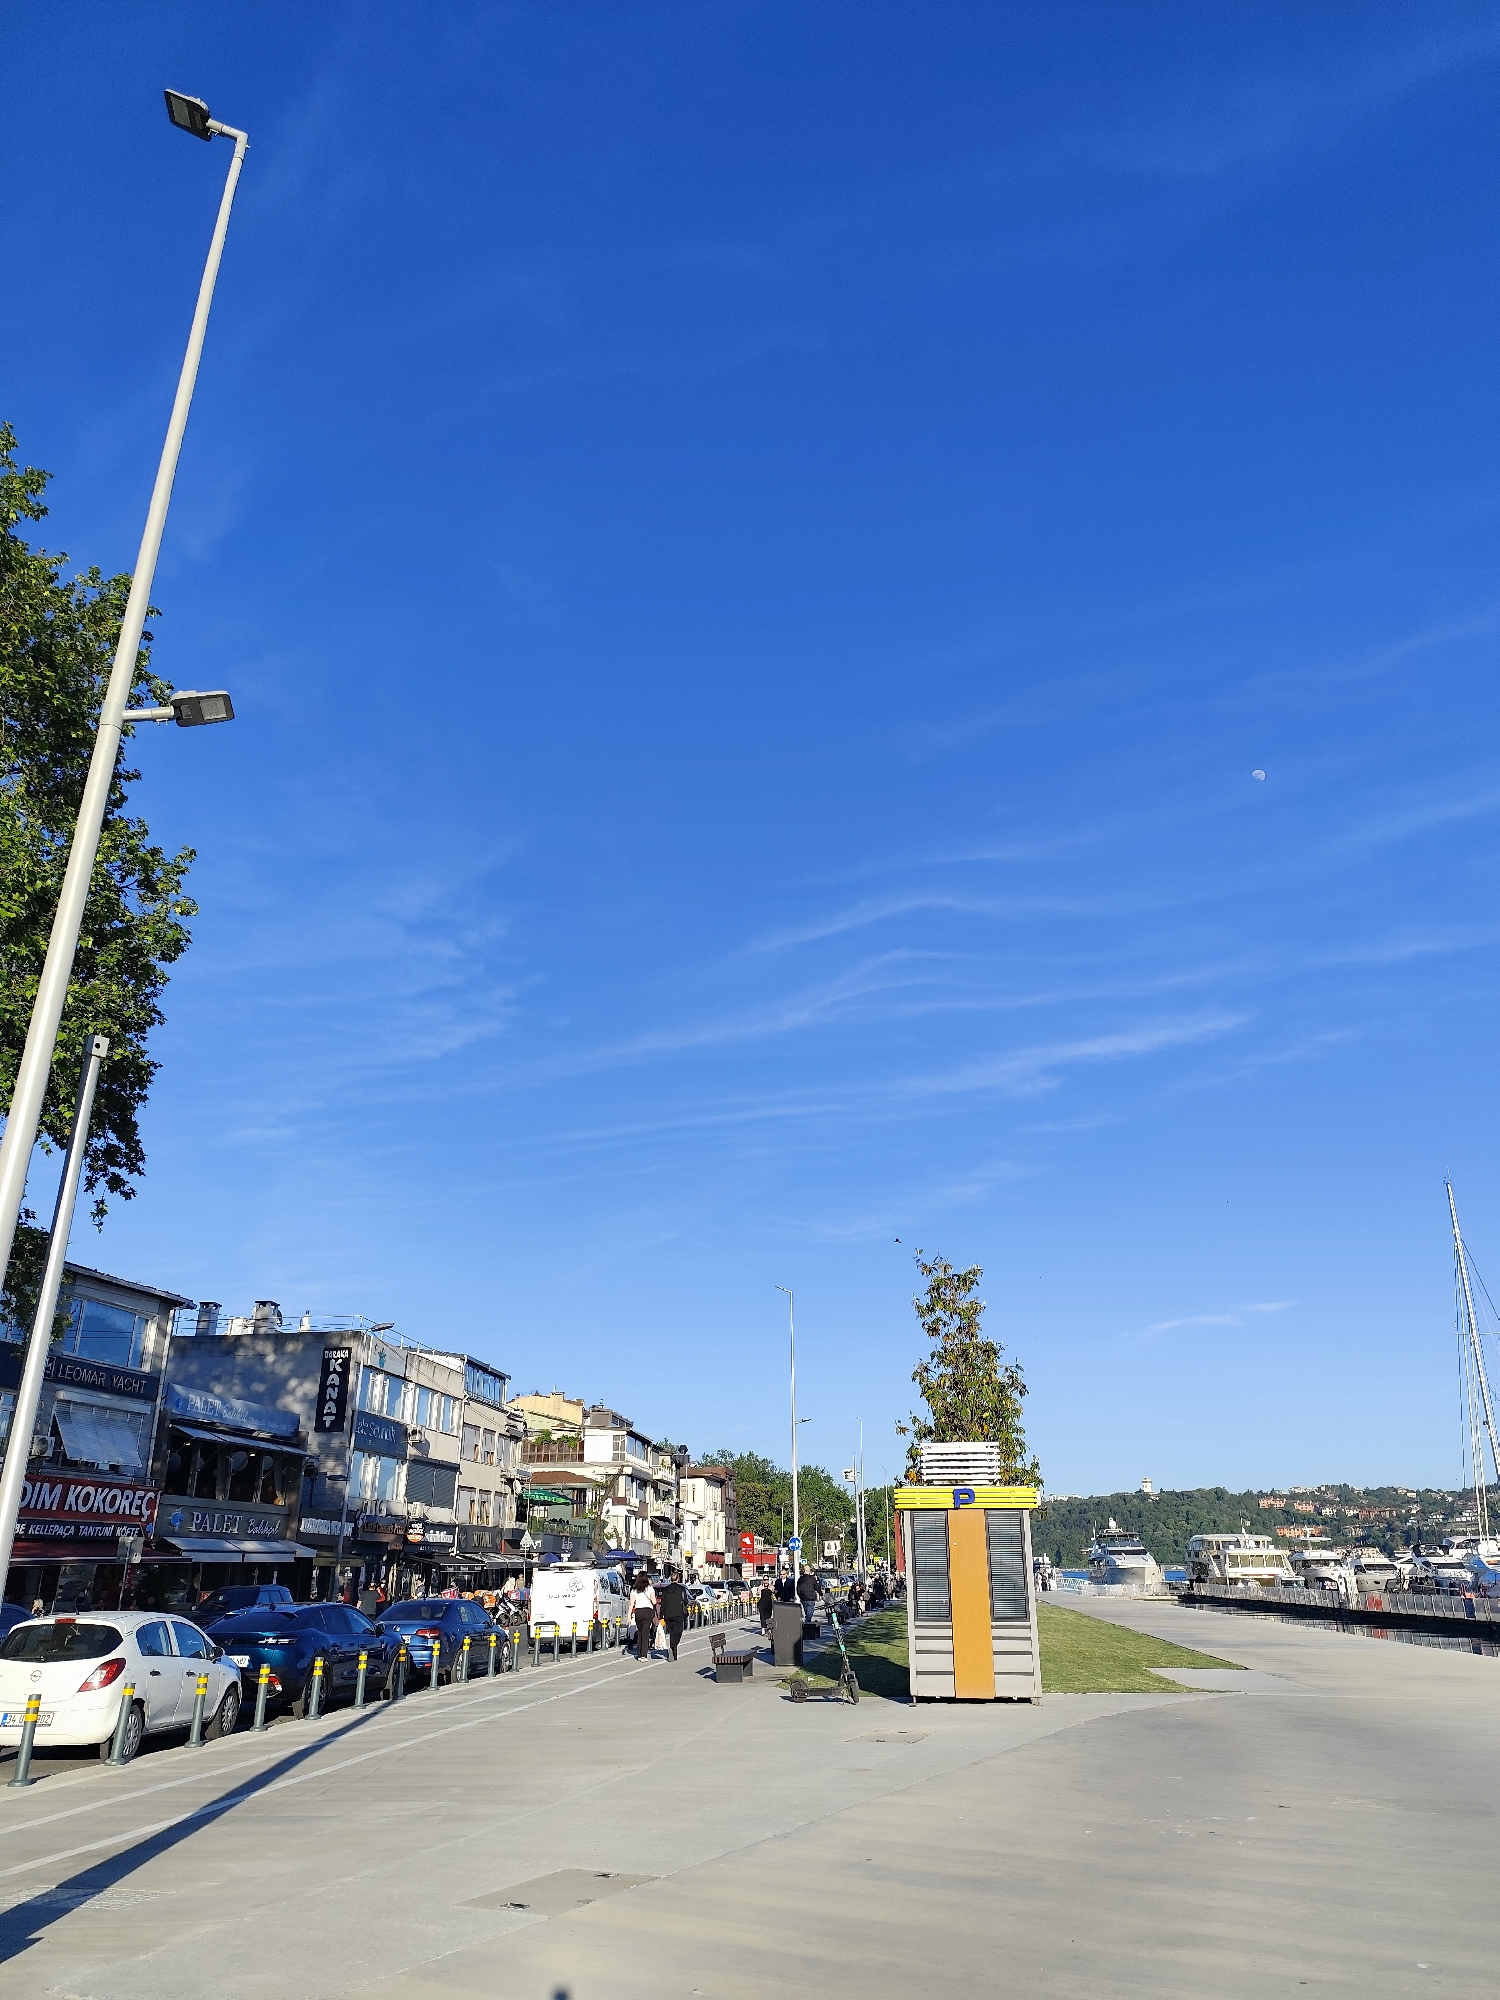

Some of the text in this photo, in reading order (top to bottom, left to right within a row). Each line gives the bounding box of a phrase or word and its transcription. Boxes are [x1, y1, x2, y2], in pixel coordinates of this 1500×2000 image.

[58, 1363, 107, 1387] LEOMAR
[112, 1374, 147, 1394] YACHT
[187, 1393, 222, 1417] PALET
[322, 1359, 342, 1428] KANAT
[18, 1481, 156, 1522] DIM KOKOREÇ
[953, 1488, 975, 1509] P
[14, 1523, 26, 1535] BE
[28, 1523, 75, 1538] KELLEPAÇA
[115, 1525, 140, 1538] KÖFTE
[192, 1511, 243, 1534] PALET
[7, 1714, 16, 1725] 34
